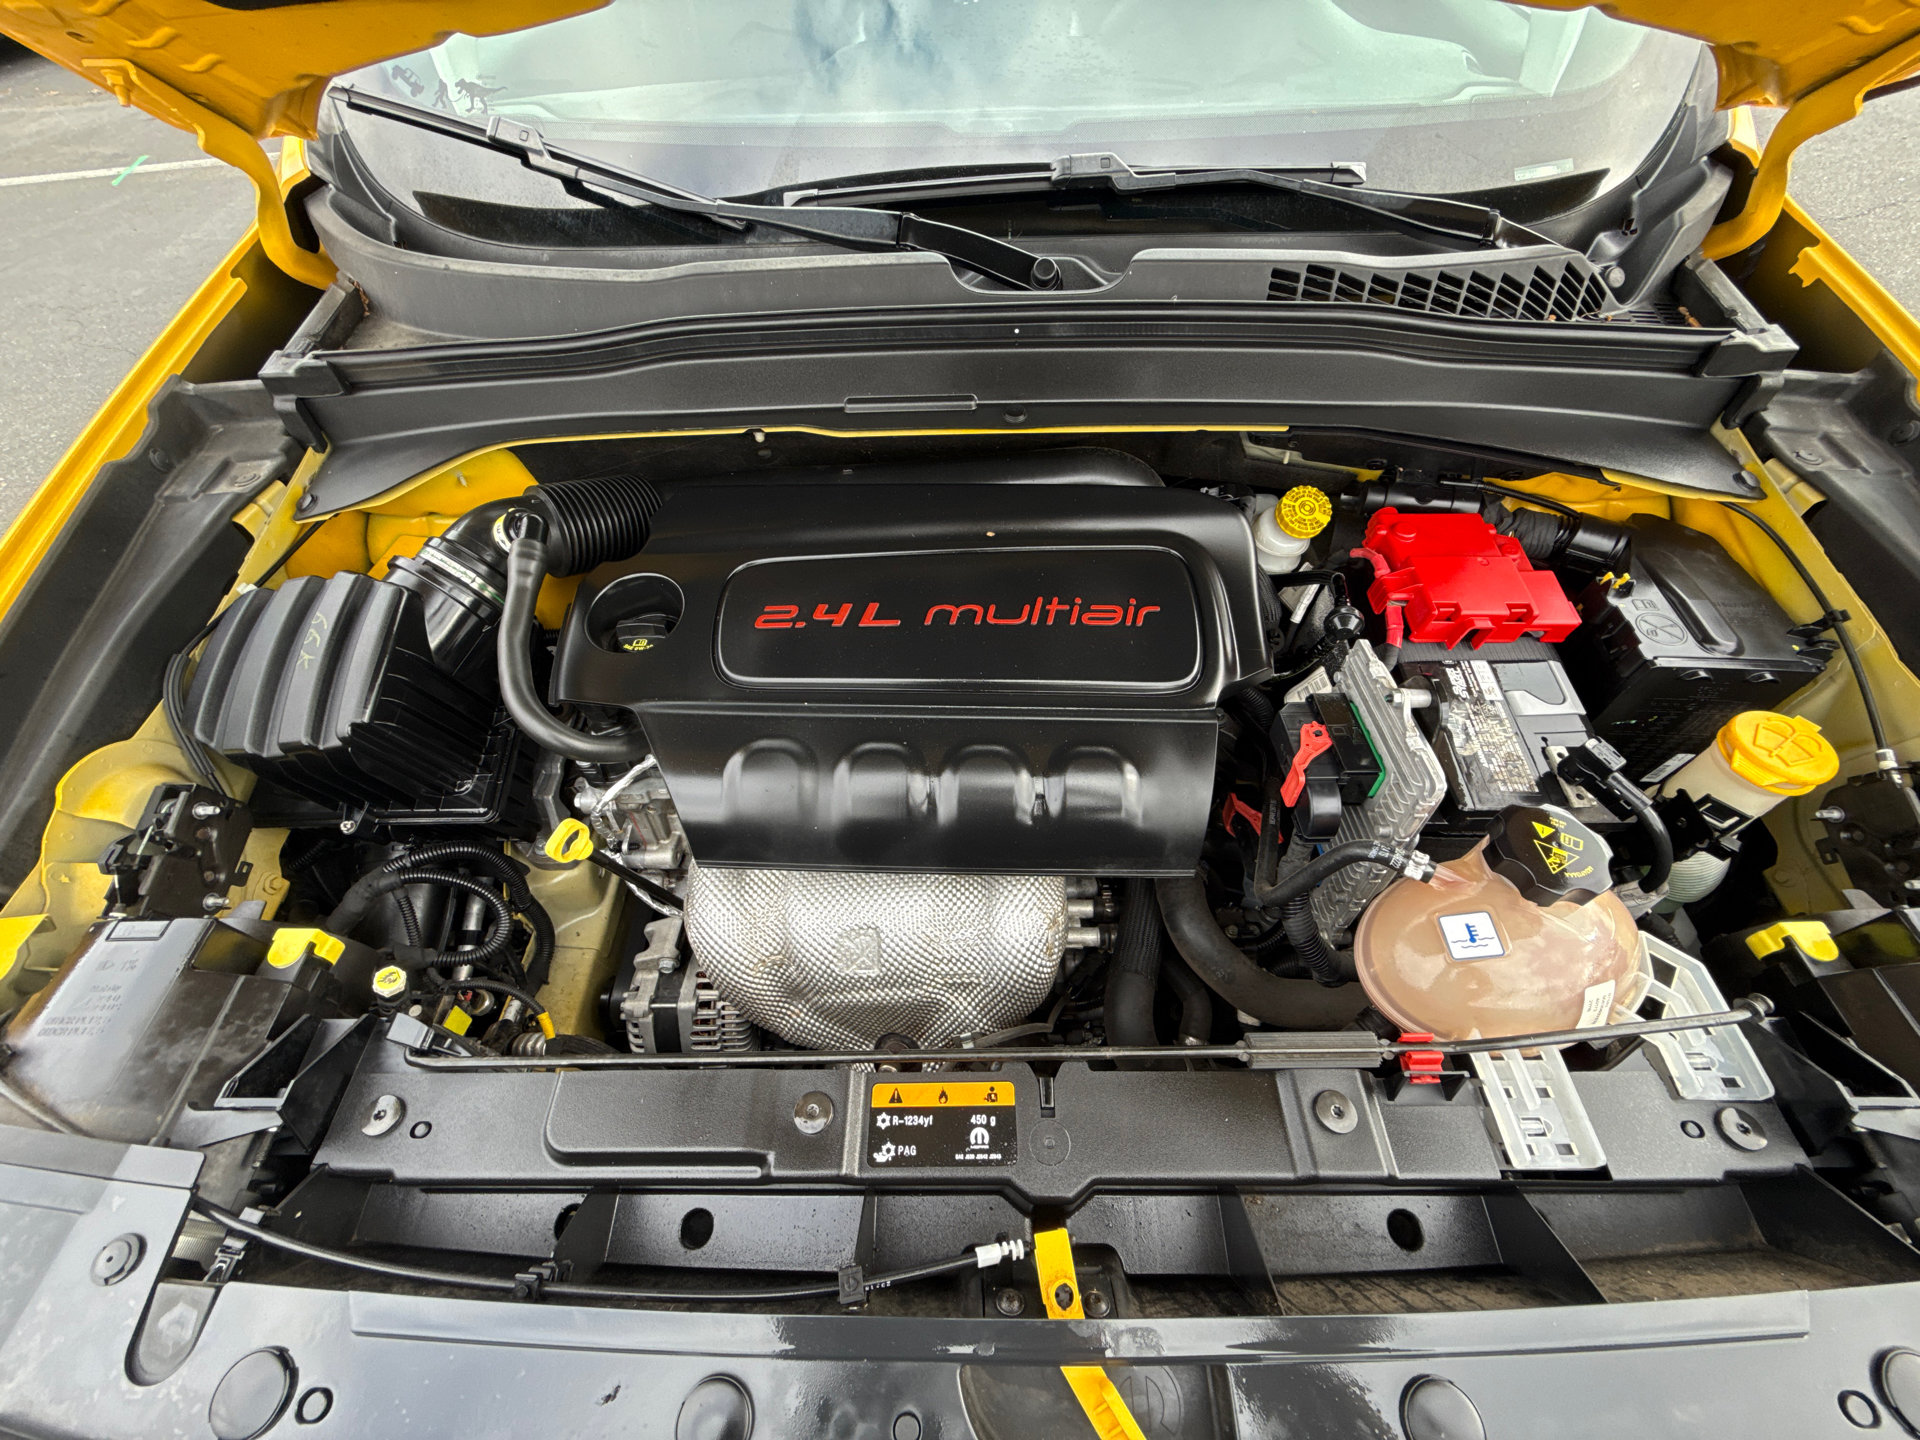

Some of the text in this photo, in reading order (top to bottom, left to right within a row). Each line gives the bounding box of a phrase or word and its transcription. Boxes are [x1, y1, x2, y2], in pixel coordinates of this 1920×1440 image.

[924, 596, 1161, 627] multiair
[892, 1114, 933, 1128] R-1234yf
[970, 1114, 996, 1127] 450 g
[897, 1144, 917, 1156] PAG
